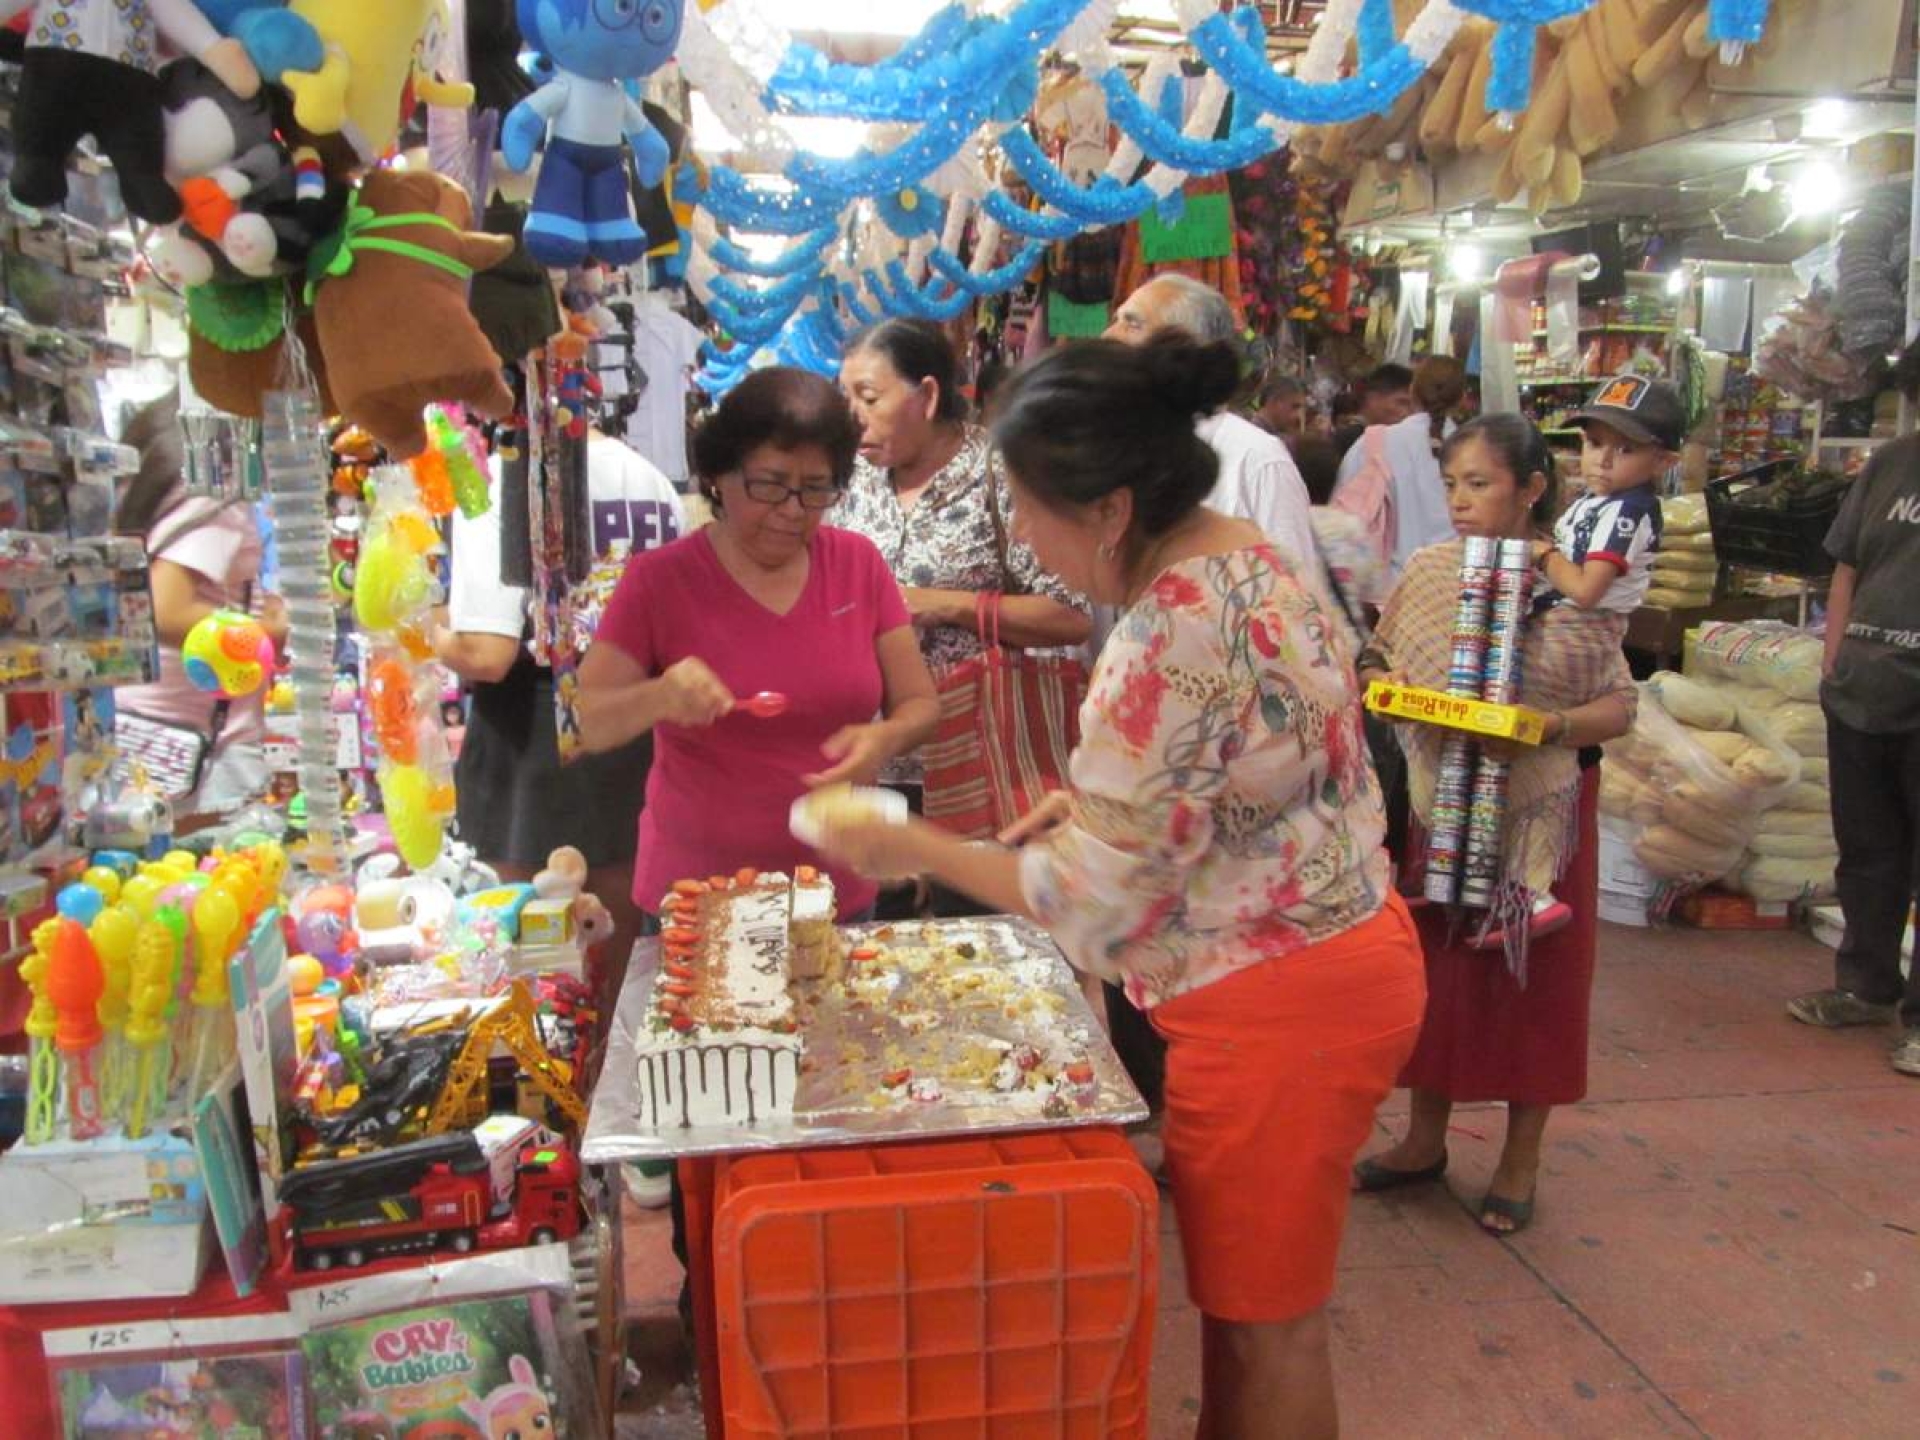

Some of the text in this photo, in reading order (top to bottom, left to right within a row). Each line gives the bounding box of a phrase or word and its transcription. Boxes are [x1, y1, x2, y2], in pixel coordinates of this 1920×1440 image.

[1401, 691, 1436, 716] Rosa
[374, 1320, 452, 1363] CRY
[362, 1351, 472, 1389] Babies
